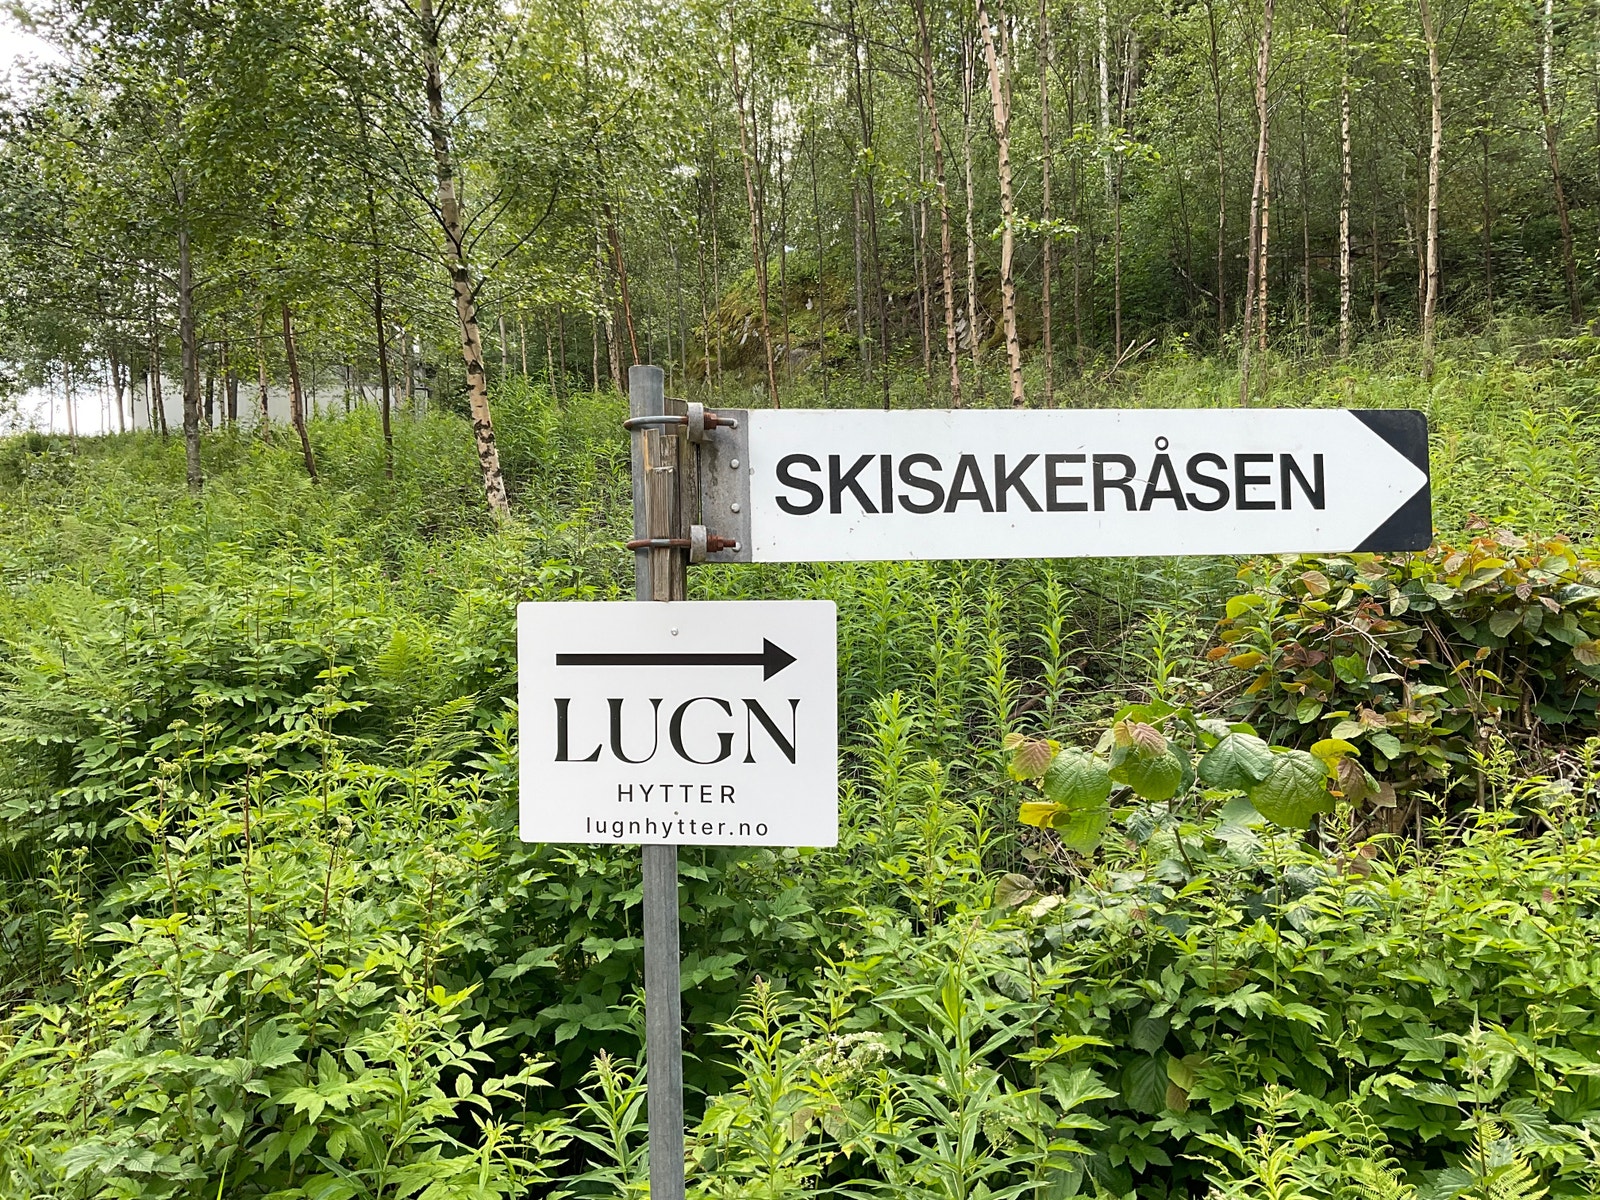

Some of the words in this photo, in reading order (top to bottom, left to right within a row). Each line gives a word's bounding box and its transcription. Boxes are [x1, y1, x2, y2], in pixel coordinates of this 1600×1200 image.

[775, 436, 1326, 515] SKISAKERÅSEN
[553, 696, 801, 765] LUGN
[617, 783, 736, 804] HYTTER
[585, 816, 769, 839] lugnhytter.no
